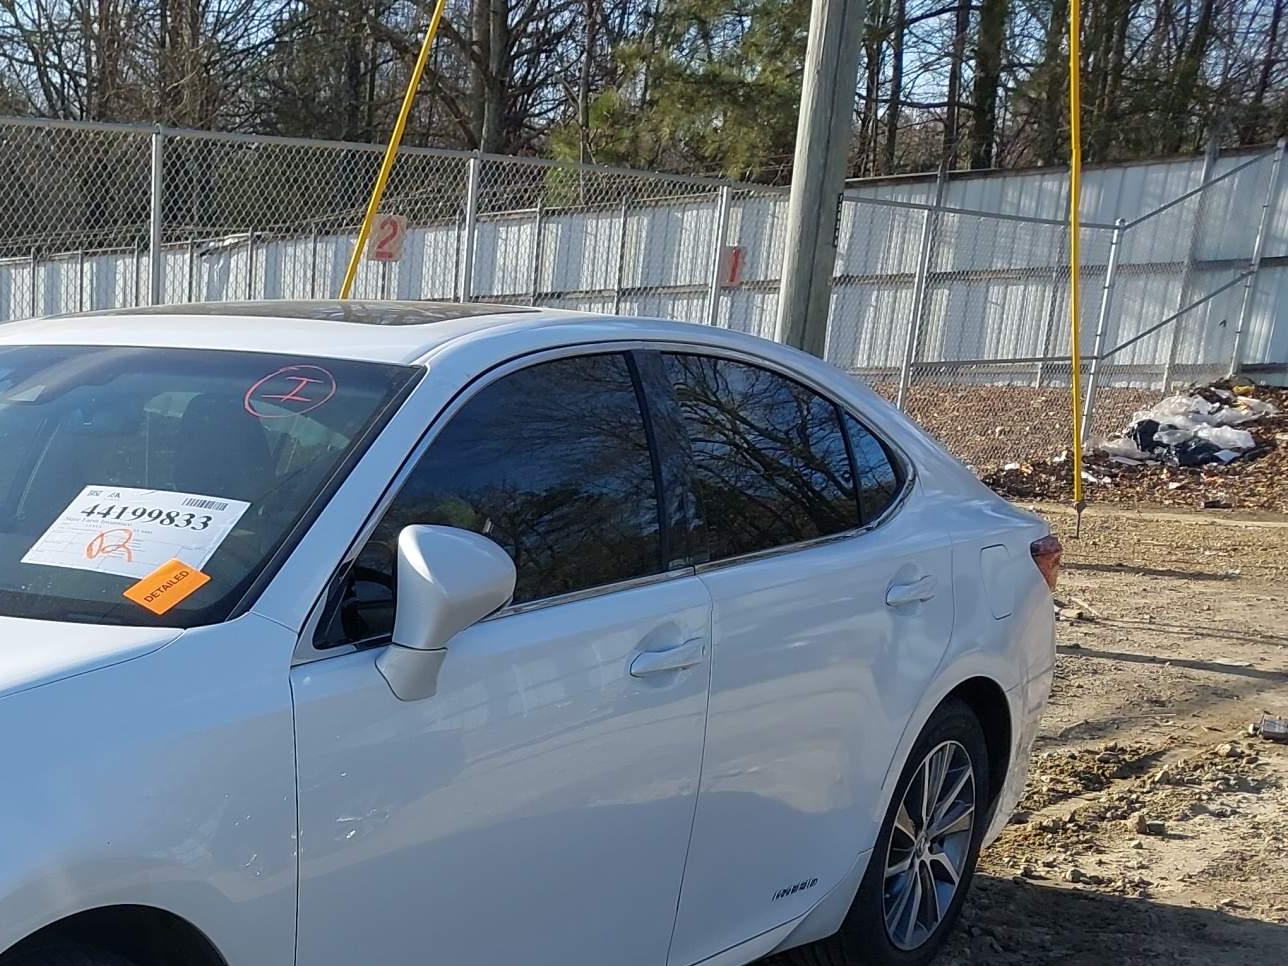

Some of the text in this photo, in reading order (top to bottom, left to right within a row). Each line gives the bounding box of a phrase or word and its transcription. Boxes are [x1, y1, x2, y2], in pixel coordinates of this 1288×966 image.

[375, 216, 399, 260] 2
[80, 503, 213, 531] 44199833
[143, 570, 190, 603] DETAILED
